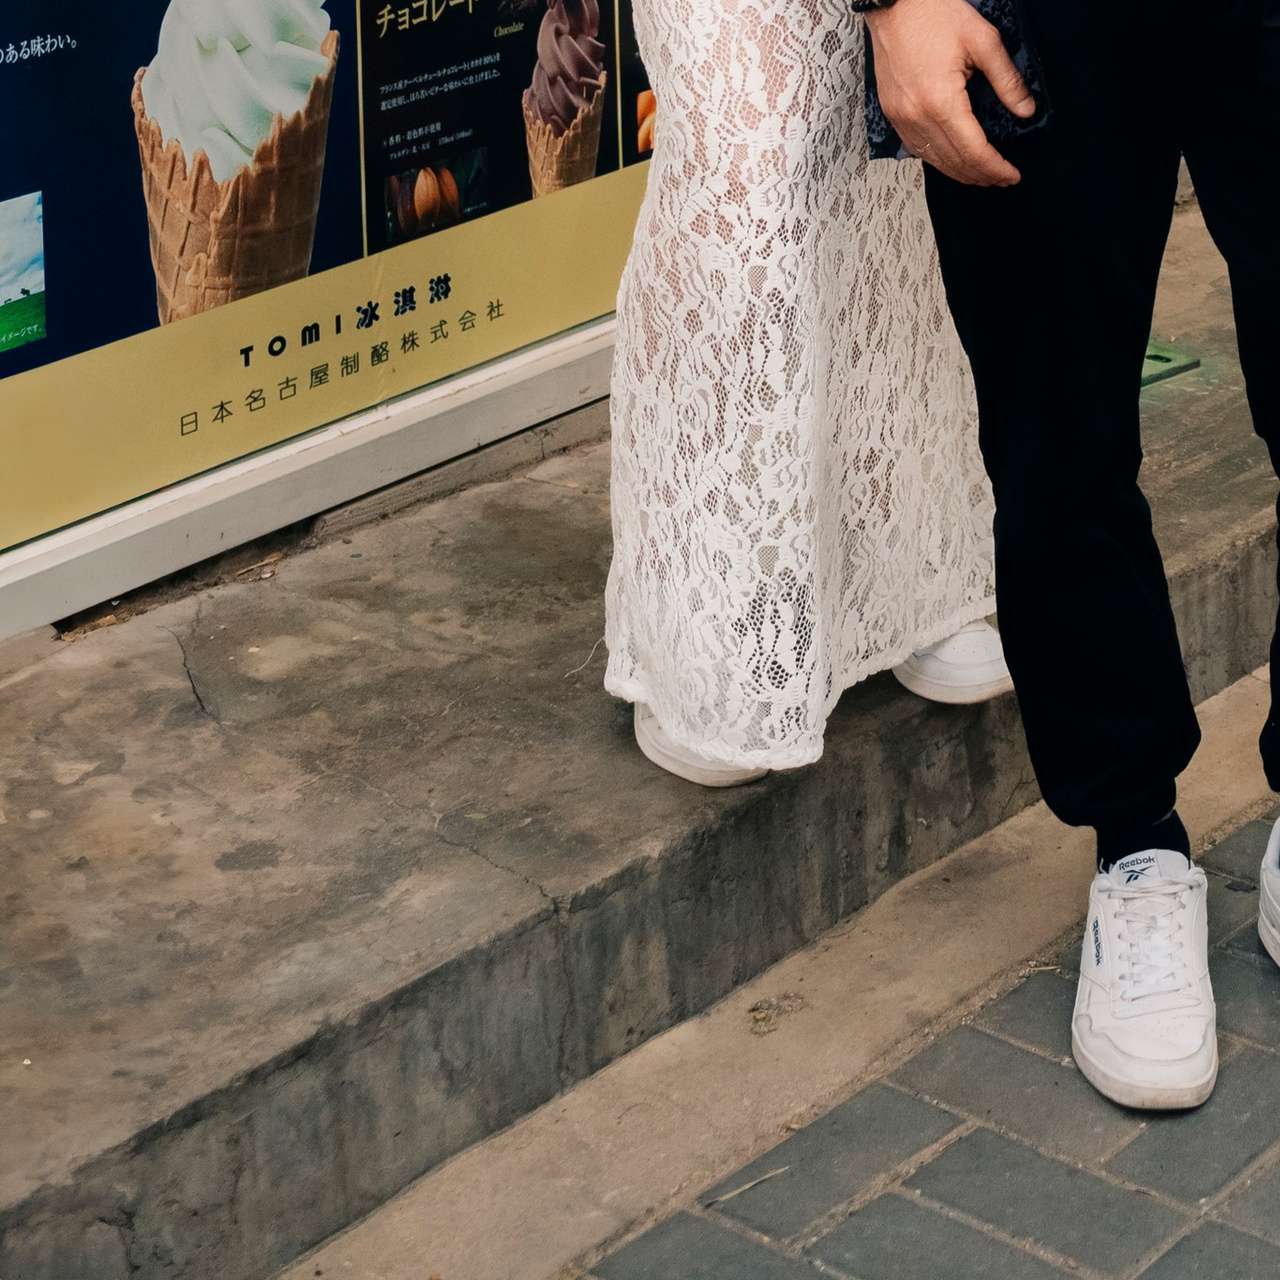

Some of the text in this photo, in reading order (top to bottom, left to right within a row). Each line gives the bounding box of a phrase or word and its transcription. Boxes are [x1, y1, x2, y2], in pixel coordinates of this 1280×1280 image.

[493, 21, 525, 38] Chocolate
[1118, 855, 1156, 871] Reebok
[1092, 919, 1103, 966] Reebok
